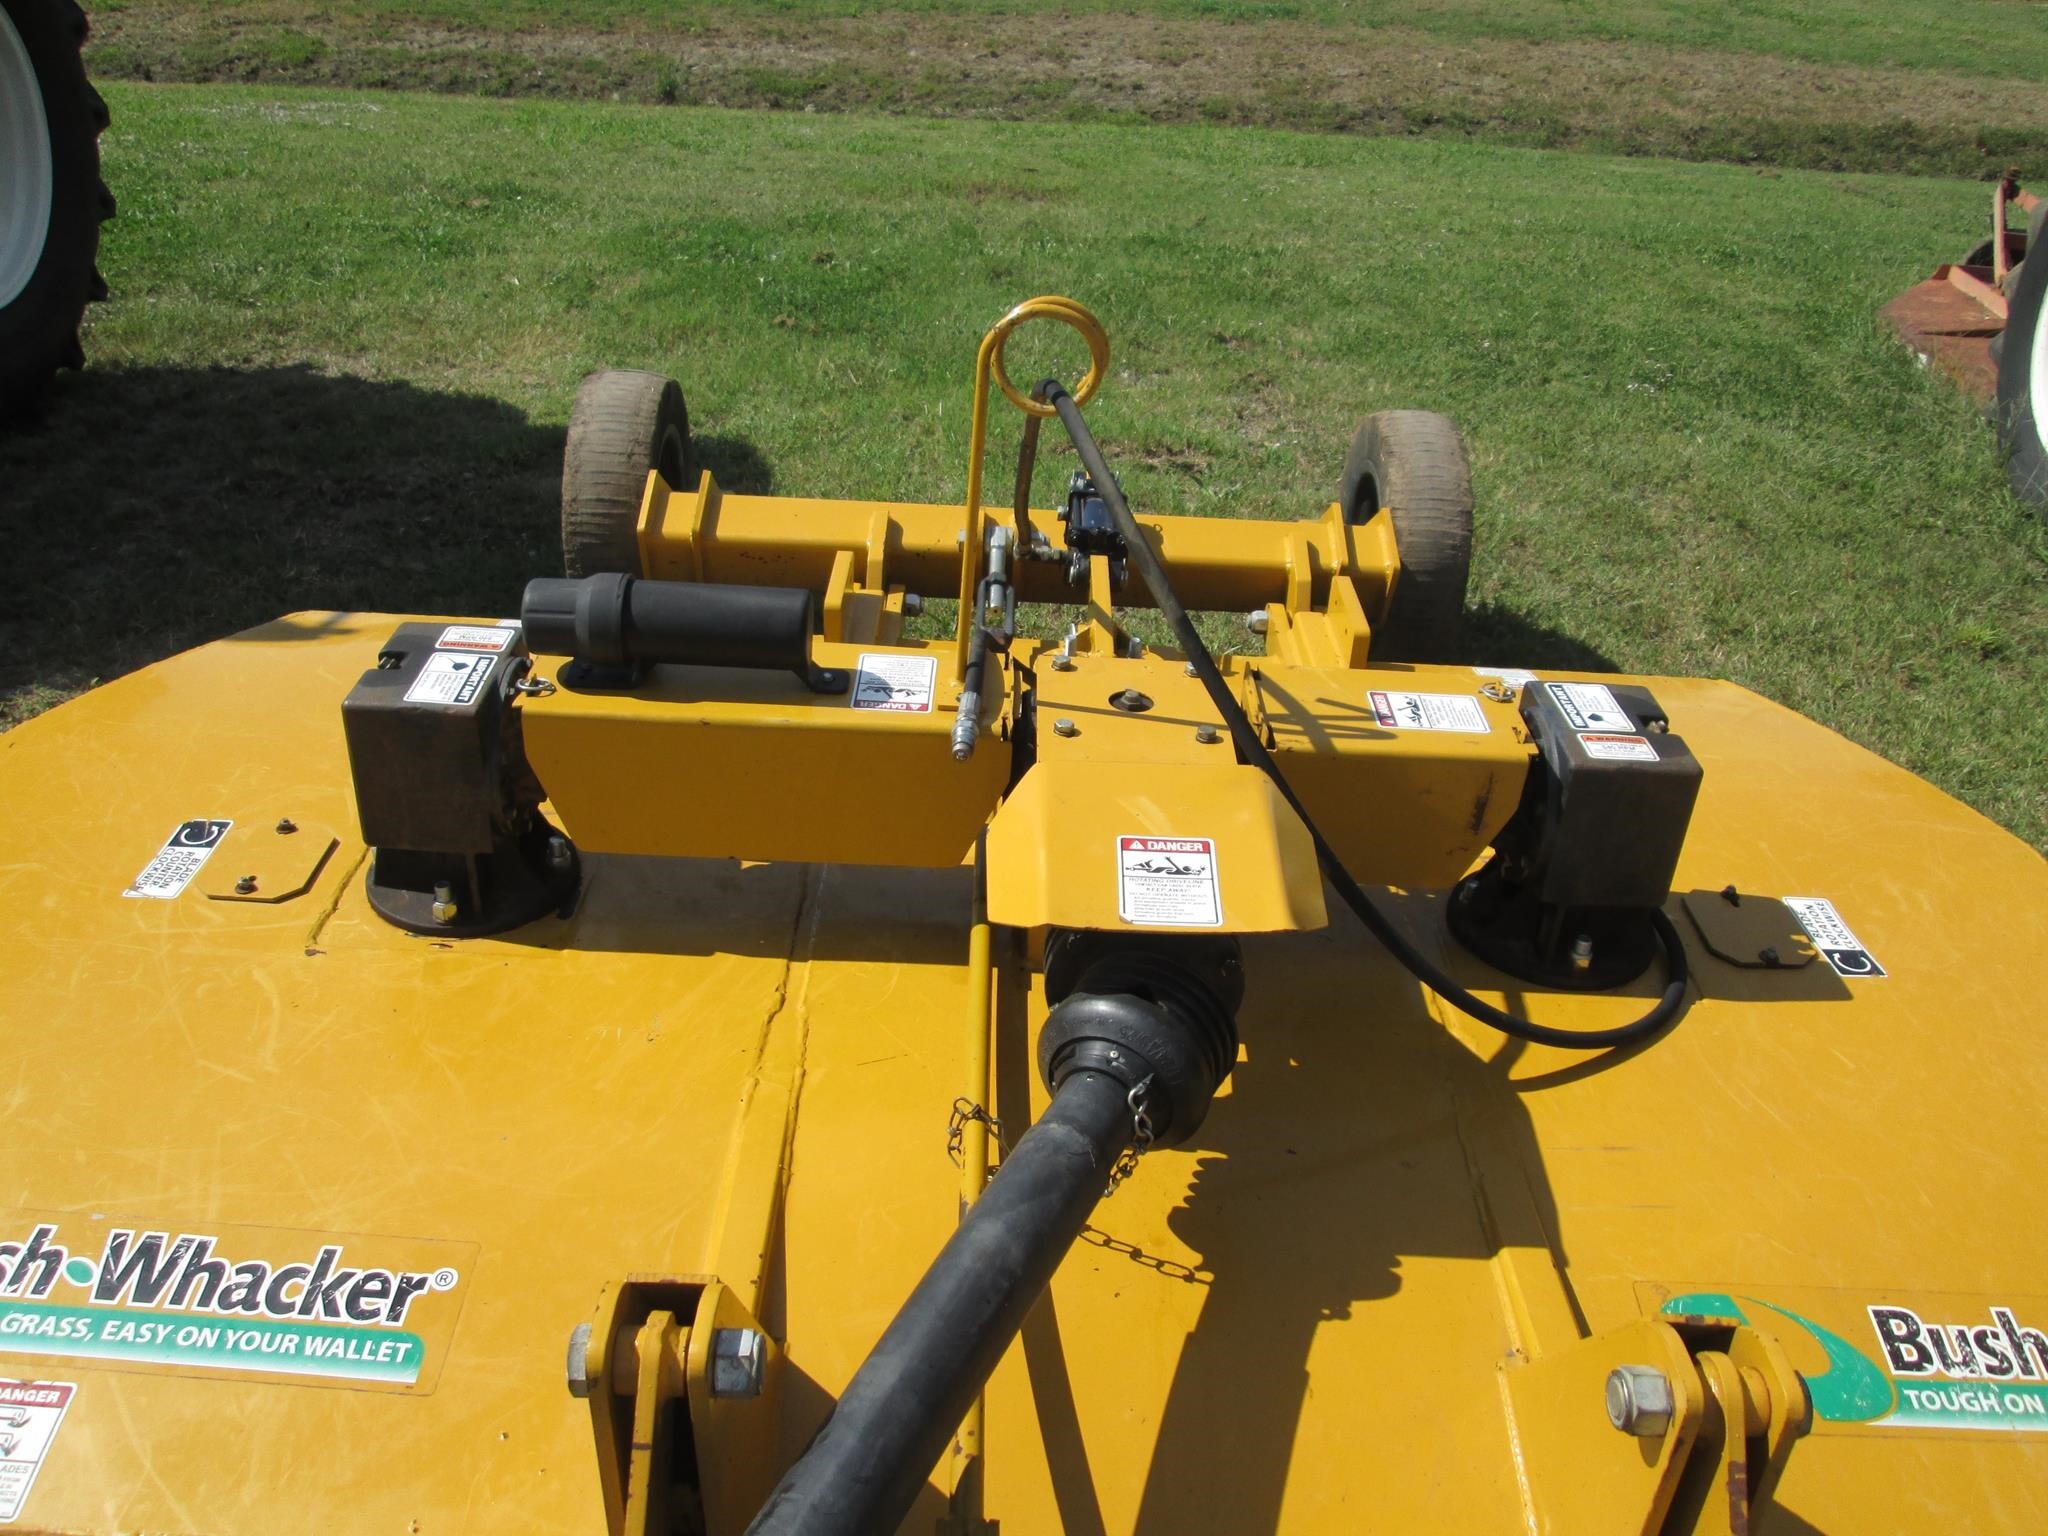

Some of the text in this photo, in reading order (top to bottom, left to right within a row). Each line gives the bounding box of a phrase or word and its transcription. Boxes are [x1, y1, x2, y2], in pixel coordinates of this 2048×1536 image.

[459, 659, 490, 702] IMPORTANT
[860, 701, 907, 710] DANGER
[1551, 686, 1586, 727] IMPORTANT
[1147, 841, 1204, 851] DANGER
[158, 851, 195, 889] ROTATION
[176, 858, 201, 883] BLADE
[1798, 911, 1823, 939] BLADE
[1803, 903, 1842, 946] ROTATION
[1814, 901, 1856, 949] CLOCKWISE
[0, 1312, 412, 1363] GRASS, EASY ON YOUR WALLET
[1868, 1306, 2048, 1380] Bush
[0, 1386, 61, 1403] ANGER
[1903, 1389, 2046, 1414] TOUGH ON
